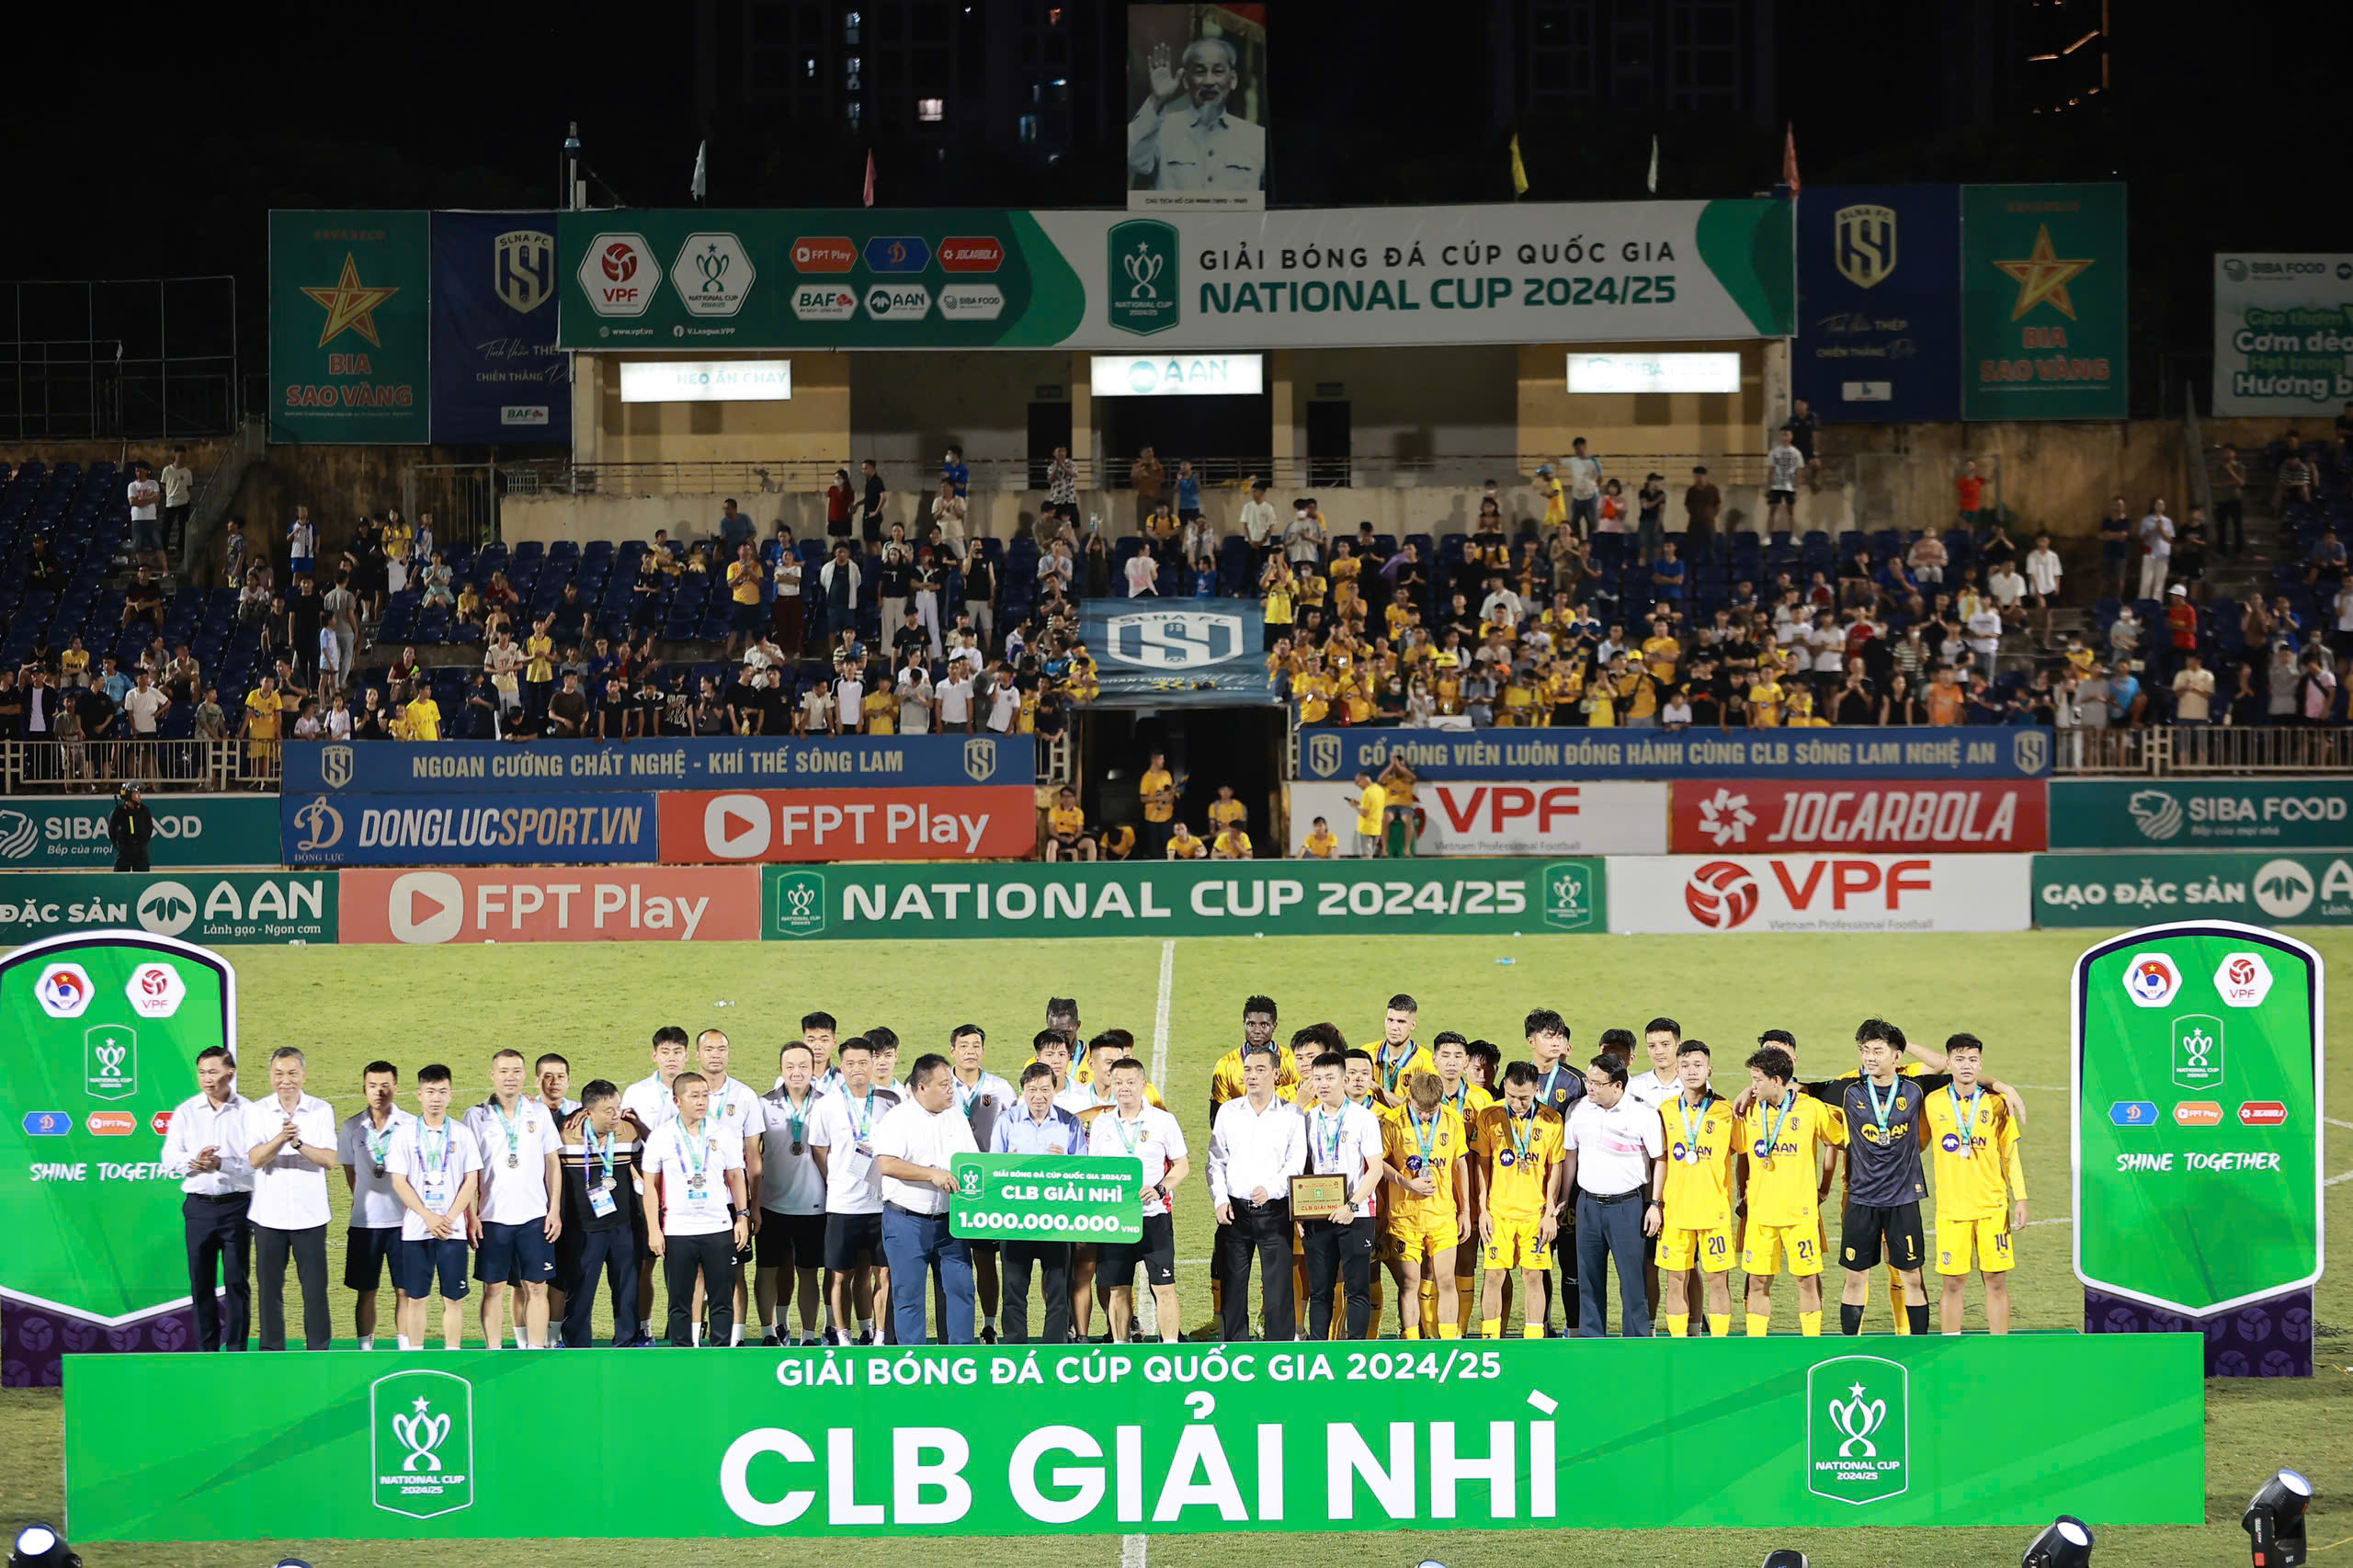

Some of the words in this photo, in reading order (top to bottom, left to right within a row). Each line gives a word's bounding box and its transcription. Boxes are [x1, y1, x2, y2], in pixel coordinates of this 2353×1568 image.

[499, 233, 530, 247] SLNA
[534, 234, 550, 247] FC
[812, 249, 829, 260] FPT
[831, 249, 851, 262] Play
[1199, 242, 1264, 270] GIẢI
[1281, 244, 1368, 268] BÓNG
[1384, 241, 1426, 267] ĐÁ
[1442, 240, 1501, 266] CÚP
[1518, 234, 1605, 264] QUỐC
[1622, 242, 1675, 262] GIA
[603, 288, 639, 302] VPF
[799, 292, 836, 307] BAF
[892, 293, 925, 306] AAN
[978, 296, 1000, 305] FOOD
[1200, 278, 1421, 313] NATIONAL
[1430, 278, 1513, 309] CUP
[1524, 275, 1676, 306] 2024/25
[1114, 301, 1155, 309] NATIONAL
[1155, 301, 1174, 309] CUP
[2022, 325, 2068, 350] BIA
[2235, 330, 2302, 352] Cơm
[328, 353, 372, 376] BIA
[1979, 359, 2033, 382] SAO
[2034, 355, 2111, 381] VÀNG
[286, 383, 339, 408] SAO
[339, 380, 414, 408] VÀNG
[506, 408, 532, 419] BAF
[413, 756, 485, 778] NGOAN
[492, 751, 563, 778] CƯỜNG
[570, 747, 624, 776] CHẤT
[631, 749, 687, 778] NGHỆ
[709, 747, 744, 774] KHÍ
[750, 745, 790, 774] THẾ
[795, 746, 853, 773] SÔNG
[859, 750, 904, 773] LAM
[1358, 736, 1387, 767] CỔ
[1454, 739, 1501, 766] VIÊN
[1506, 739, 1560, 766] LUÔN
[1565, 737, 1623, 766] ĐỒNG
[1626, 738, 1682, 766] HÀNH
[1688, 739, 1745, 765] CÙNG
[1751, 743, 1790, 764] CLB
[1795, 739, 1852, 765] SÔNG
[1857, 743, 1901, 764] LAM
[1906, 738, 1960, 769] NGHỆ
[1966, 743, 1996, 764] AN
[1435, 786, 1581, 835] VPF
[1767, 790, 2018, 843] JOGARBOLA
[2188, 797, 2257, 822] SIBA
[2263, 797, 2347, 822] FOOD
[45, 816, 111, 840] SIBA
[358, 806, 642, 847] DONGLUCSPORT.VN
[782, 803, 875, 846] FPT
[886, 802, 990, 854] Play
[47, 844, 69, 856] Bếp
[70, 844, 90, 855] của
[92, 844, 114, 856] mọi
[1434, 840, 1476, 852] Vietnam
[1477, 839, 1540, 852] Professional
[1540, 839, 1582, 852] Football
[324, 852, 345, 863] LỰC
[1768, 858, 1932, 910] VPF
[2041, 883, 2108, 910] GẠO
[2113, 877, 2178, 909] ĐẶC
[2184, 874, 2246, 904] SẢN
[203, 880, 324, 921] AAN
[842, 881, 1172, 921] NATIONAL
[1190, 880, 1305, 917] CUP
[1317, 880, 1528, 916] 2024/25
[1, 898, 61, 928] ĐẶC
[67, 896, 128, 924] SẢN
[477, 884, 582, 930] FPT
[594, 883, 710, 941] Play
[203, 924, 233, 936] Lành
[233, 926, 256, 938] gạo
[264, 924, 296, 937] Ngon
[297, 924, 322, 935] cơm
[1768, 919, 1816, 930] Vietnam
[1817, 919, 1886, 931] Professional
[1887, 918, 1934, 930] Football
[142, 999, 168, 1009] VPF
[2229, 989, 2256, 999] VPF
[2204, 1110, 2219, 1119] Play
[29, 1162, 88, 1182] SHINE
[2117, 1152, 2175, 1173] SHINE
[2183, 1152, 2280, 1173] TOGETHER
[1010, 1170, 1031, 1178] BÓNG
[1046, 1170, 1062, 1179] CÚP
[1100, 1174, 1132, 1182] 2024/25
[1001, 1185, 1040, 1201] CLB
[1043, 1182, 1084, 1201] GIẢI
[1088, 1185, 1123, 1203] NHÌ
[958, 1211, 1120, 1233] 1.000.000.000
[1707, 1235, 1727, 1256] 20
[1797, 1238, 1814, 1259] 21
[1904, 1234, 1915, 1254] 1
[1995, 1233, 2009, 1253] 14
[776, 1349, 854, 1386] GIẢI
[868, 1350, 977, 1386] BÓNG
[991, 1349, 1045, 1385] ĐÁ
[1055, 1348, 1132, 1384] CÚP
[1143, 1344, 1256, 1383] QUỐC
[1267, 1353, 1335, 1382] GIA
[1347, 1347, 1502, 1383] 2024/25
[720, 1426, 973, 1527] CLB
[1007, 1390, 1285, 1525] GIẢI
[1326, 1388, 1560, 1521] NHÌ
[1814, 1460, 1876, 1471] NATIONAL
[1876, 1460, 1901, 1471] CUP
[379, 1474, 440, 1485] NATIONAL
[441, 1474, 466, 1484] CUP
[1836, 1471, 1879, 1481] 2024/25
[400, 1485, 445, 1495] 2024/25
